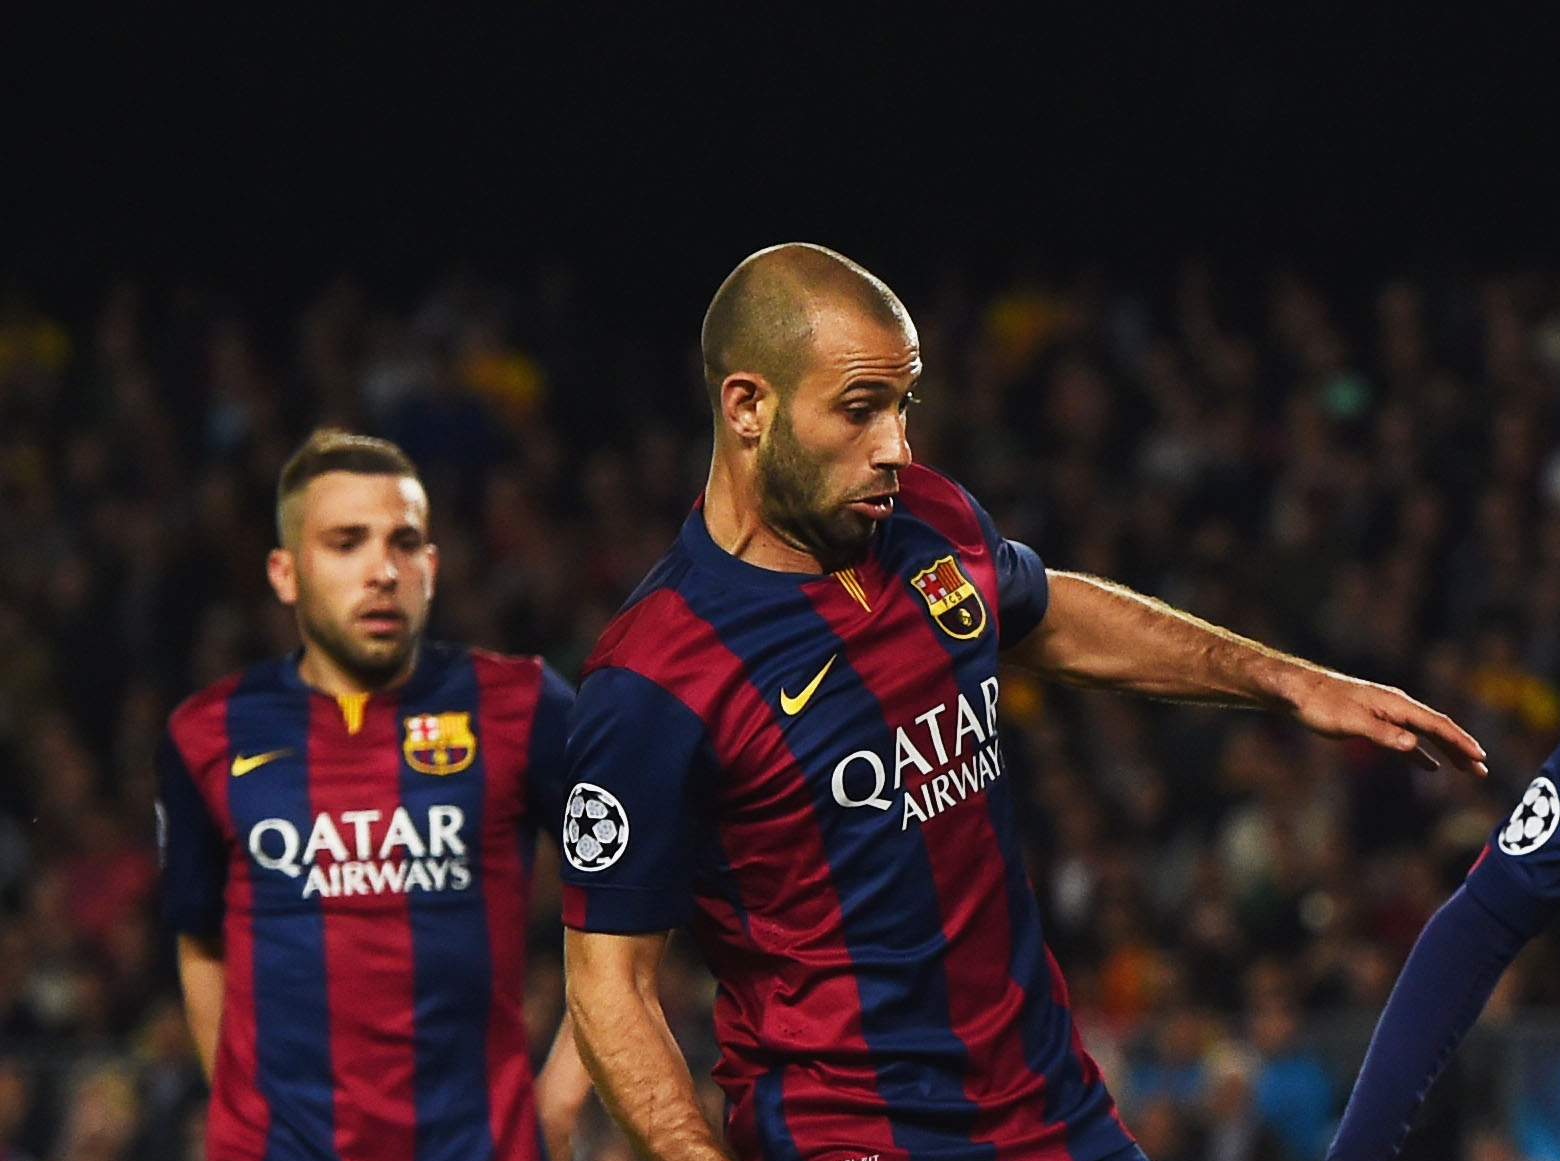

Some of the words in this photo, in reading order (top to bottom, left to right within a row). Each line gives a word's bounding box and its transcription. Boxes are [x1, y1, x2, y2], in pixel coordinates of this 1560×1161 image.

[831, 676, 999, 811] QATAR
[901, 738, 1004, 831] AIRWAY
[248, 805, 467, 878] QATAR
[302, 856, 473, 899] AIRWAYS
